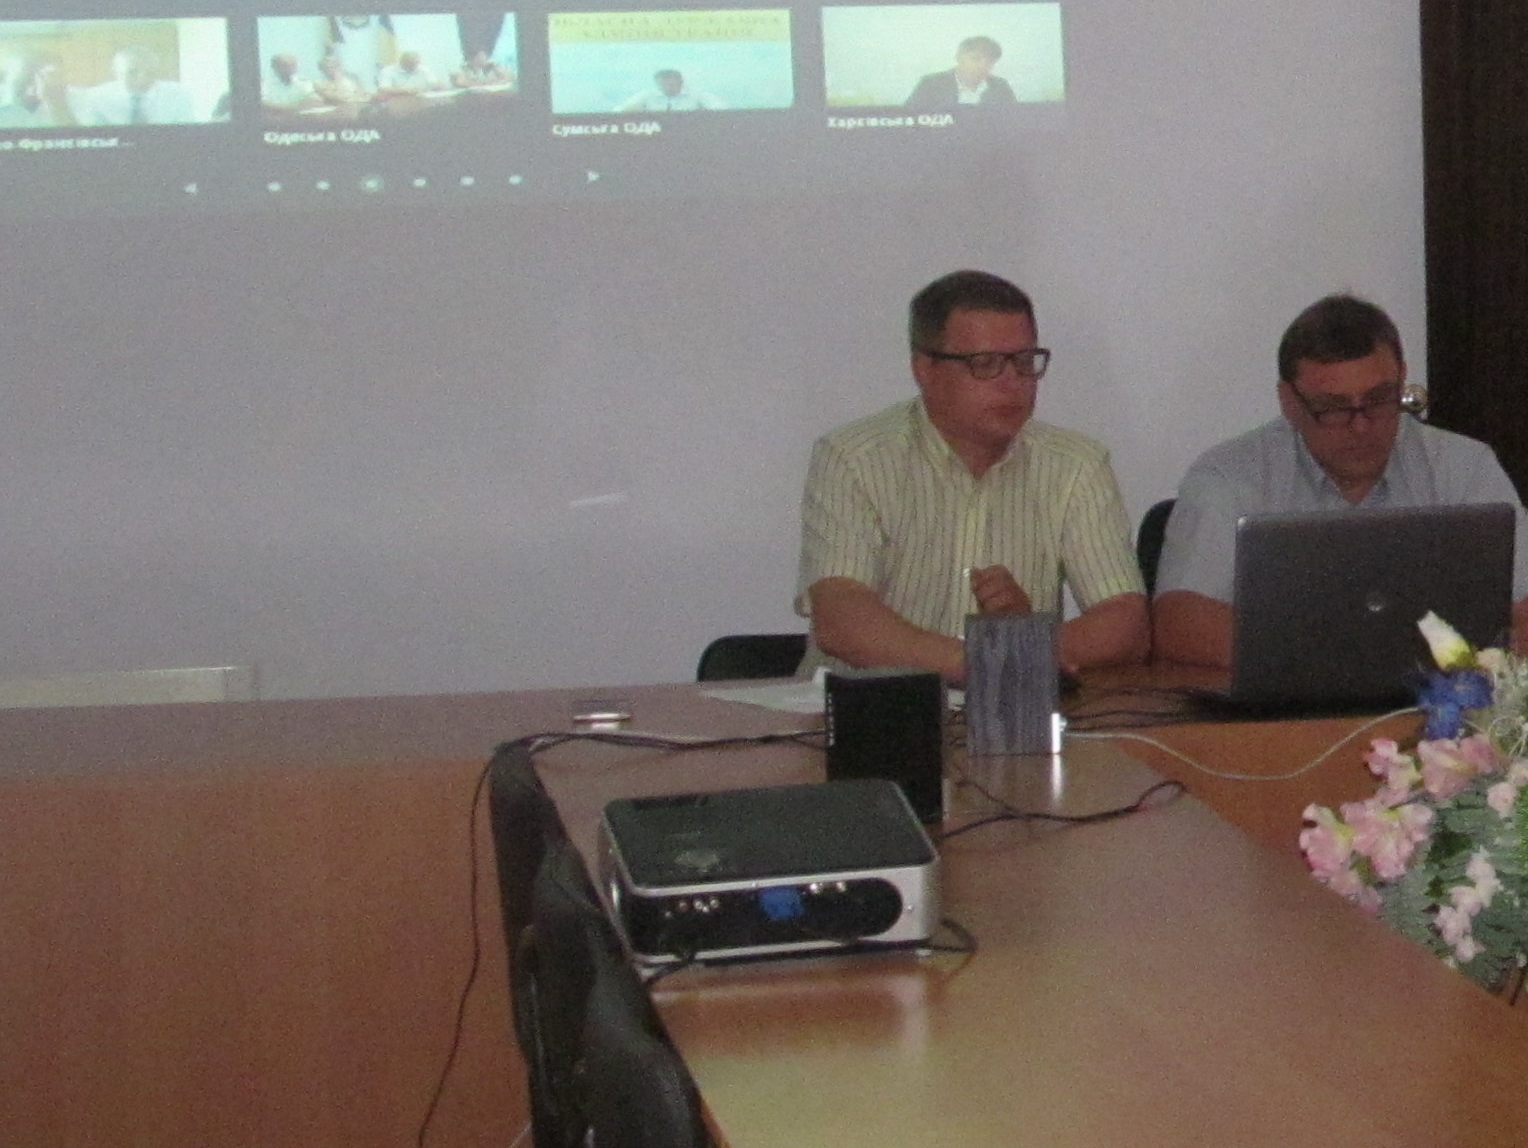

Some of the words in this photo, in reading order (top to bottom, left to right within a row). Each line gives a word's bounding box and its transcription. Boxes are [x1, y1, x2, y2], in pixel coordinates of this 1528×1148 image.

[917, 113, 954, 127] ОДА
[340, 128, 381, 144] ОДА
[552, 123, 619, 138] Сумська
[623, 121, 661, 136] ОДА
